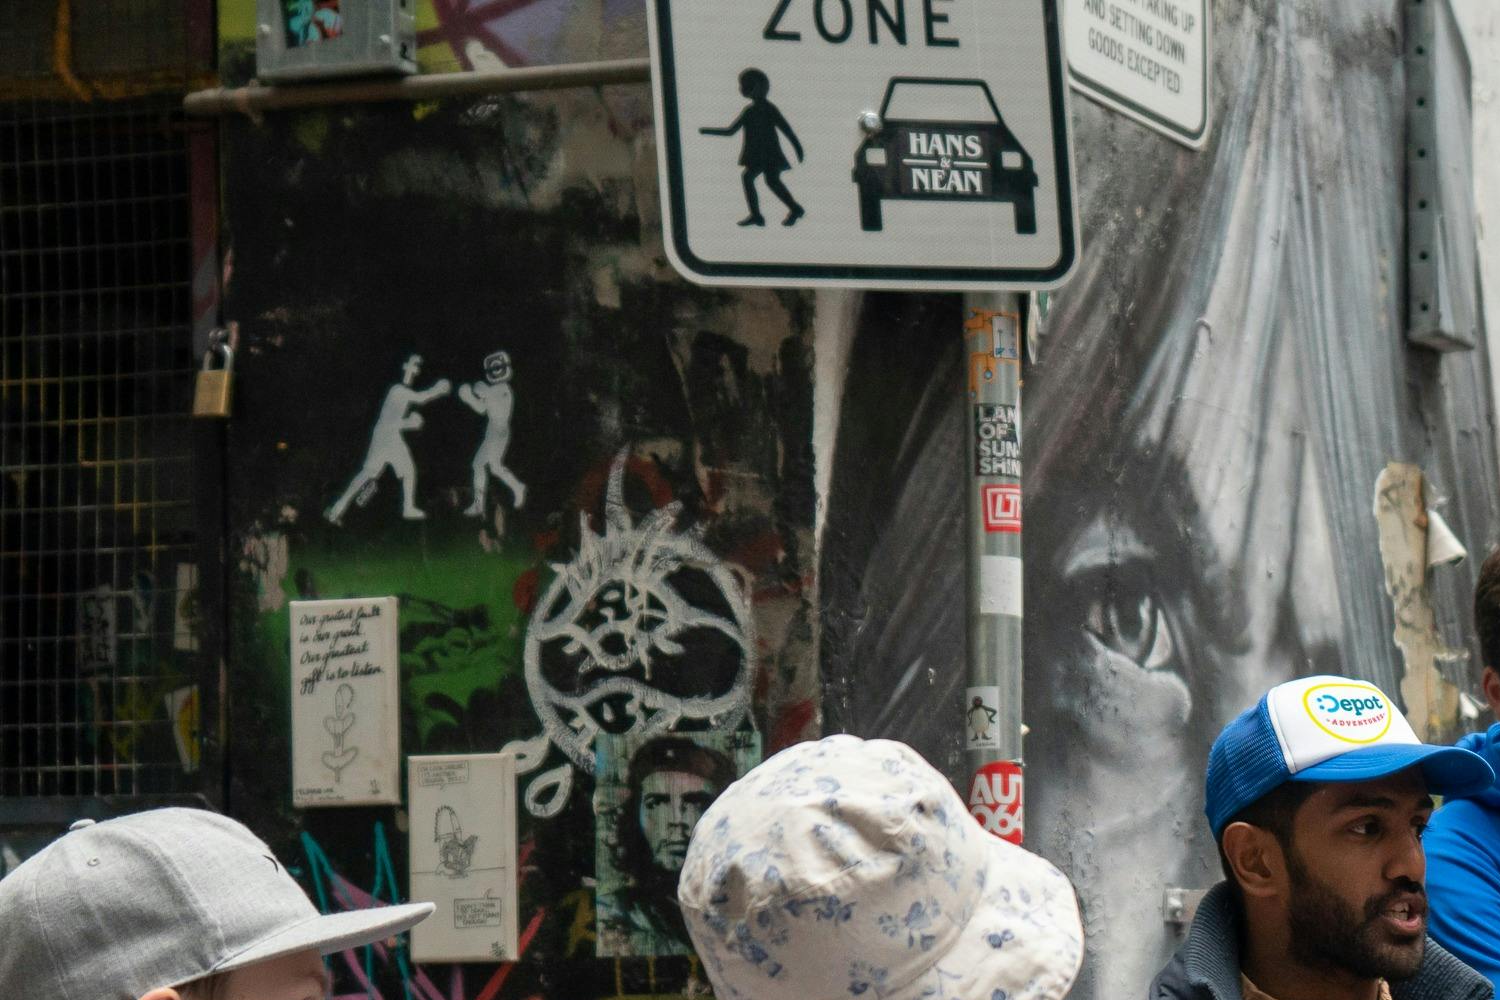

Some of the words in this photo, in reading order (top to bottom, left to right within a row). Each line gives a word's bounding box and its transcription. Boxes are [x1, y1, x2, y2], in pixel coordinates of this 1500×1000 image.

[763, 0, 960, 47] ZONE
[1109, 3, 1153, 46] SETTING
[1156, 29, 1185, 64] DOWN
[1181, 9, 1195, 34] UP
[1088, 27, 1124, 65] GOODS
[1127, 47, 1180, 94] EXCEPTED
[908, 131, 982, 158] HANS
[940, 156, 953, 168] &
[911, 168, 984, 193] NEAN
[979, 423, 1008, 440] OF
[1331, 711, 1384, 727] ADVENTURES
